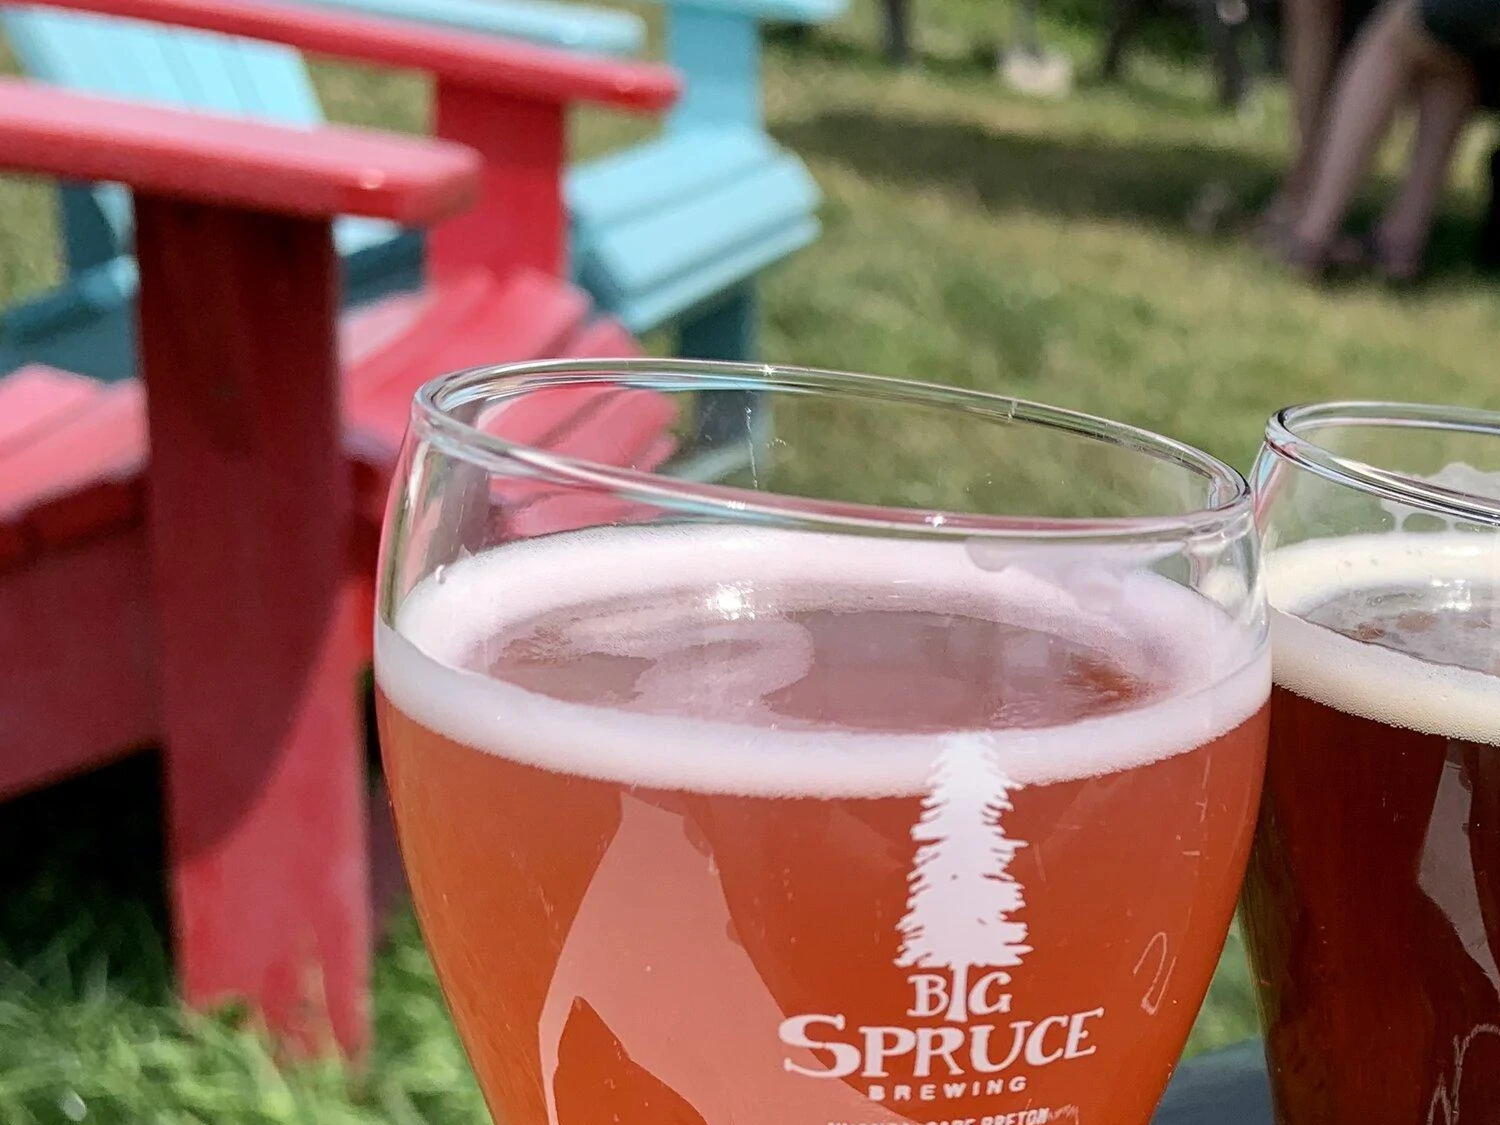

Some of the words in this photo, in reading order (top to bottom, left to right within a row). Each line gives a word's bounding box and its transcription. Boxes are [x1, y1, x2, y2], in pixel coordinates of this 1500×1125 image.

[906, 971, 1013, 1023] BIG
[777, 1006, 1105, 1078] SPRUCE
[868, 1076, 1027, 1101] BREWING
